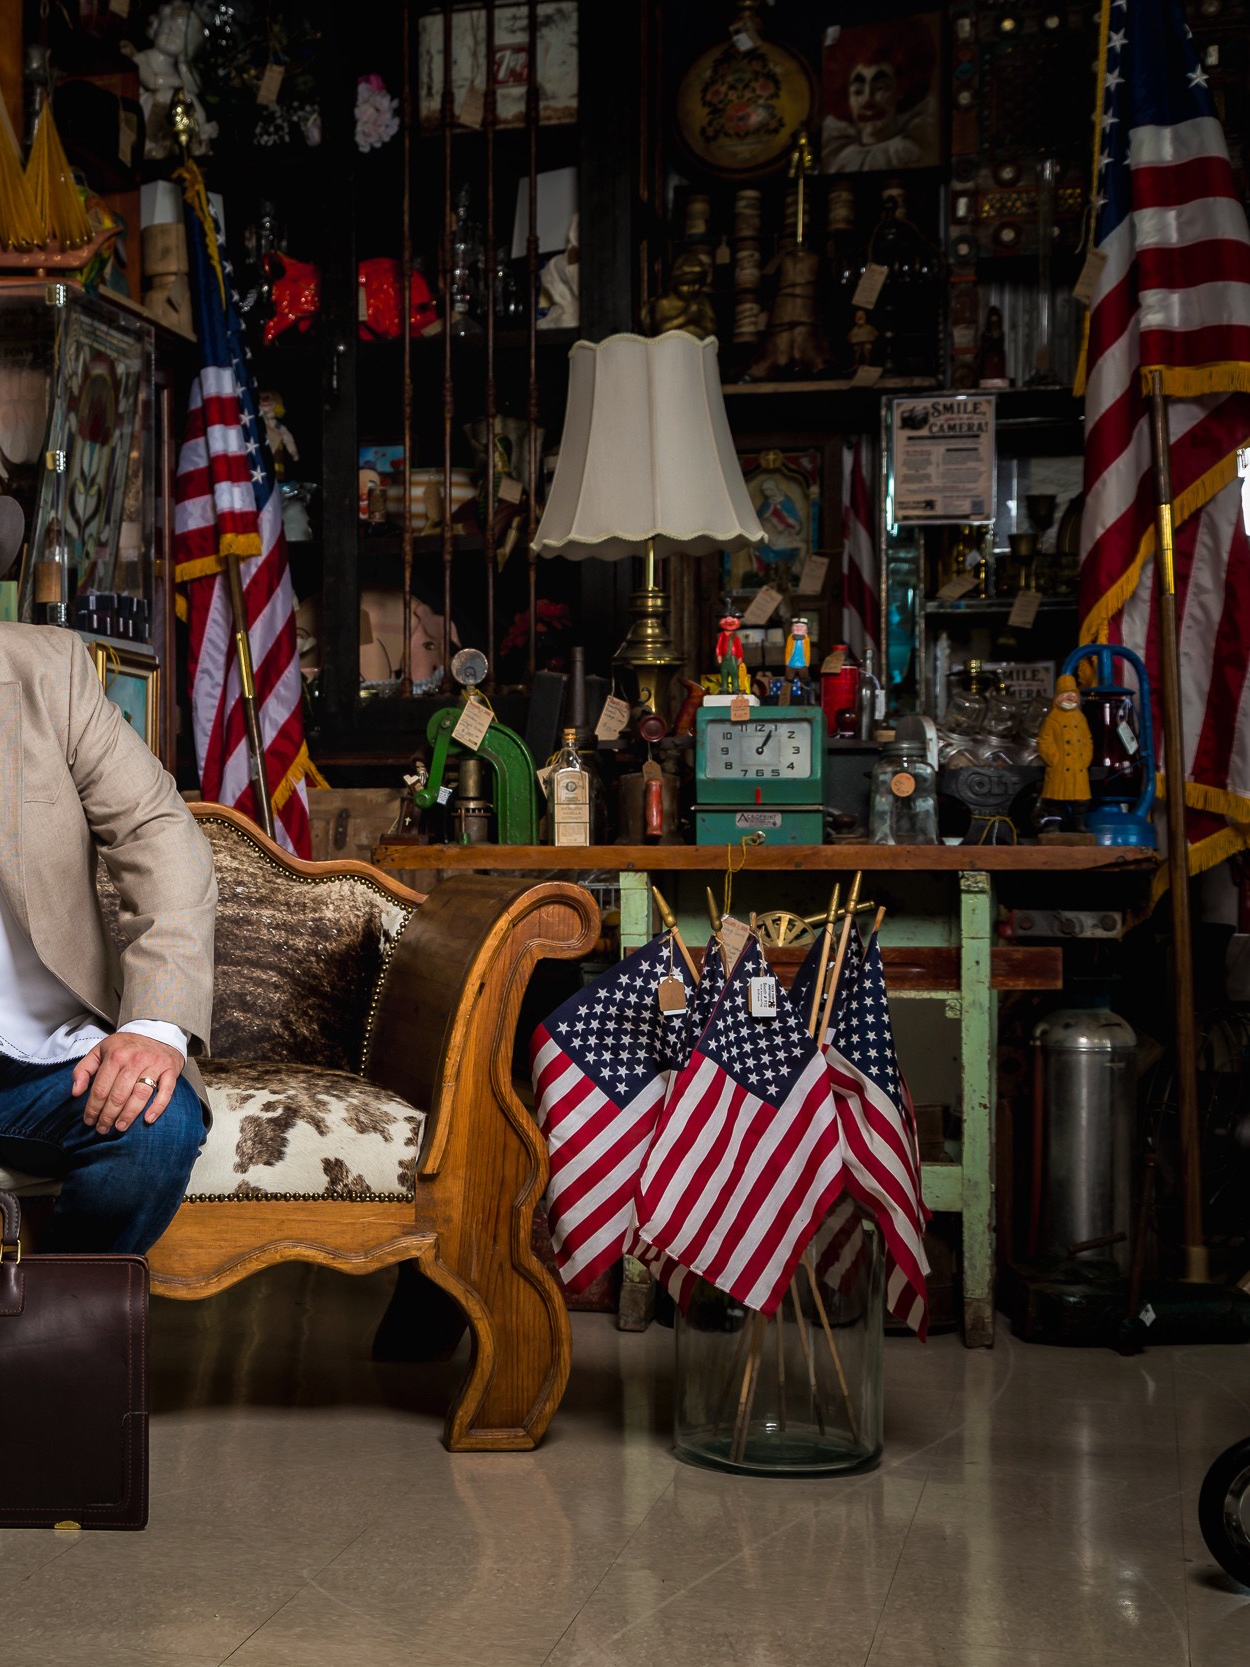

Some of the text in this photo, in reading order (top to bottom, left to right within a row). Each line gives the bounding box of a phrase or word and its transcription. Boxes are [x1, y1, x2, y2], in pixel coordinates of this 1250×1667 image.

[931, 401, 987, 418] SMILE,
[929, 421, 989, 434] CAMERA!
[1003, 669, 1045, 683] MILE,
[740, 724, 748, 732] 11
[754, 724, 766, 732] 12
[722, 731, 796, 740] 10 2
[721, 746, 801, 755] 9 3
[725, 762, 795, 770] 8 4
[741, 769, 781, 777] 7 6 5
[957, 770, 1021, 806] COLT
